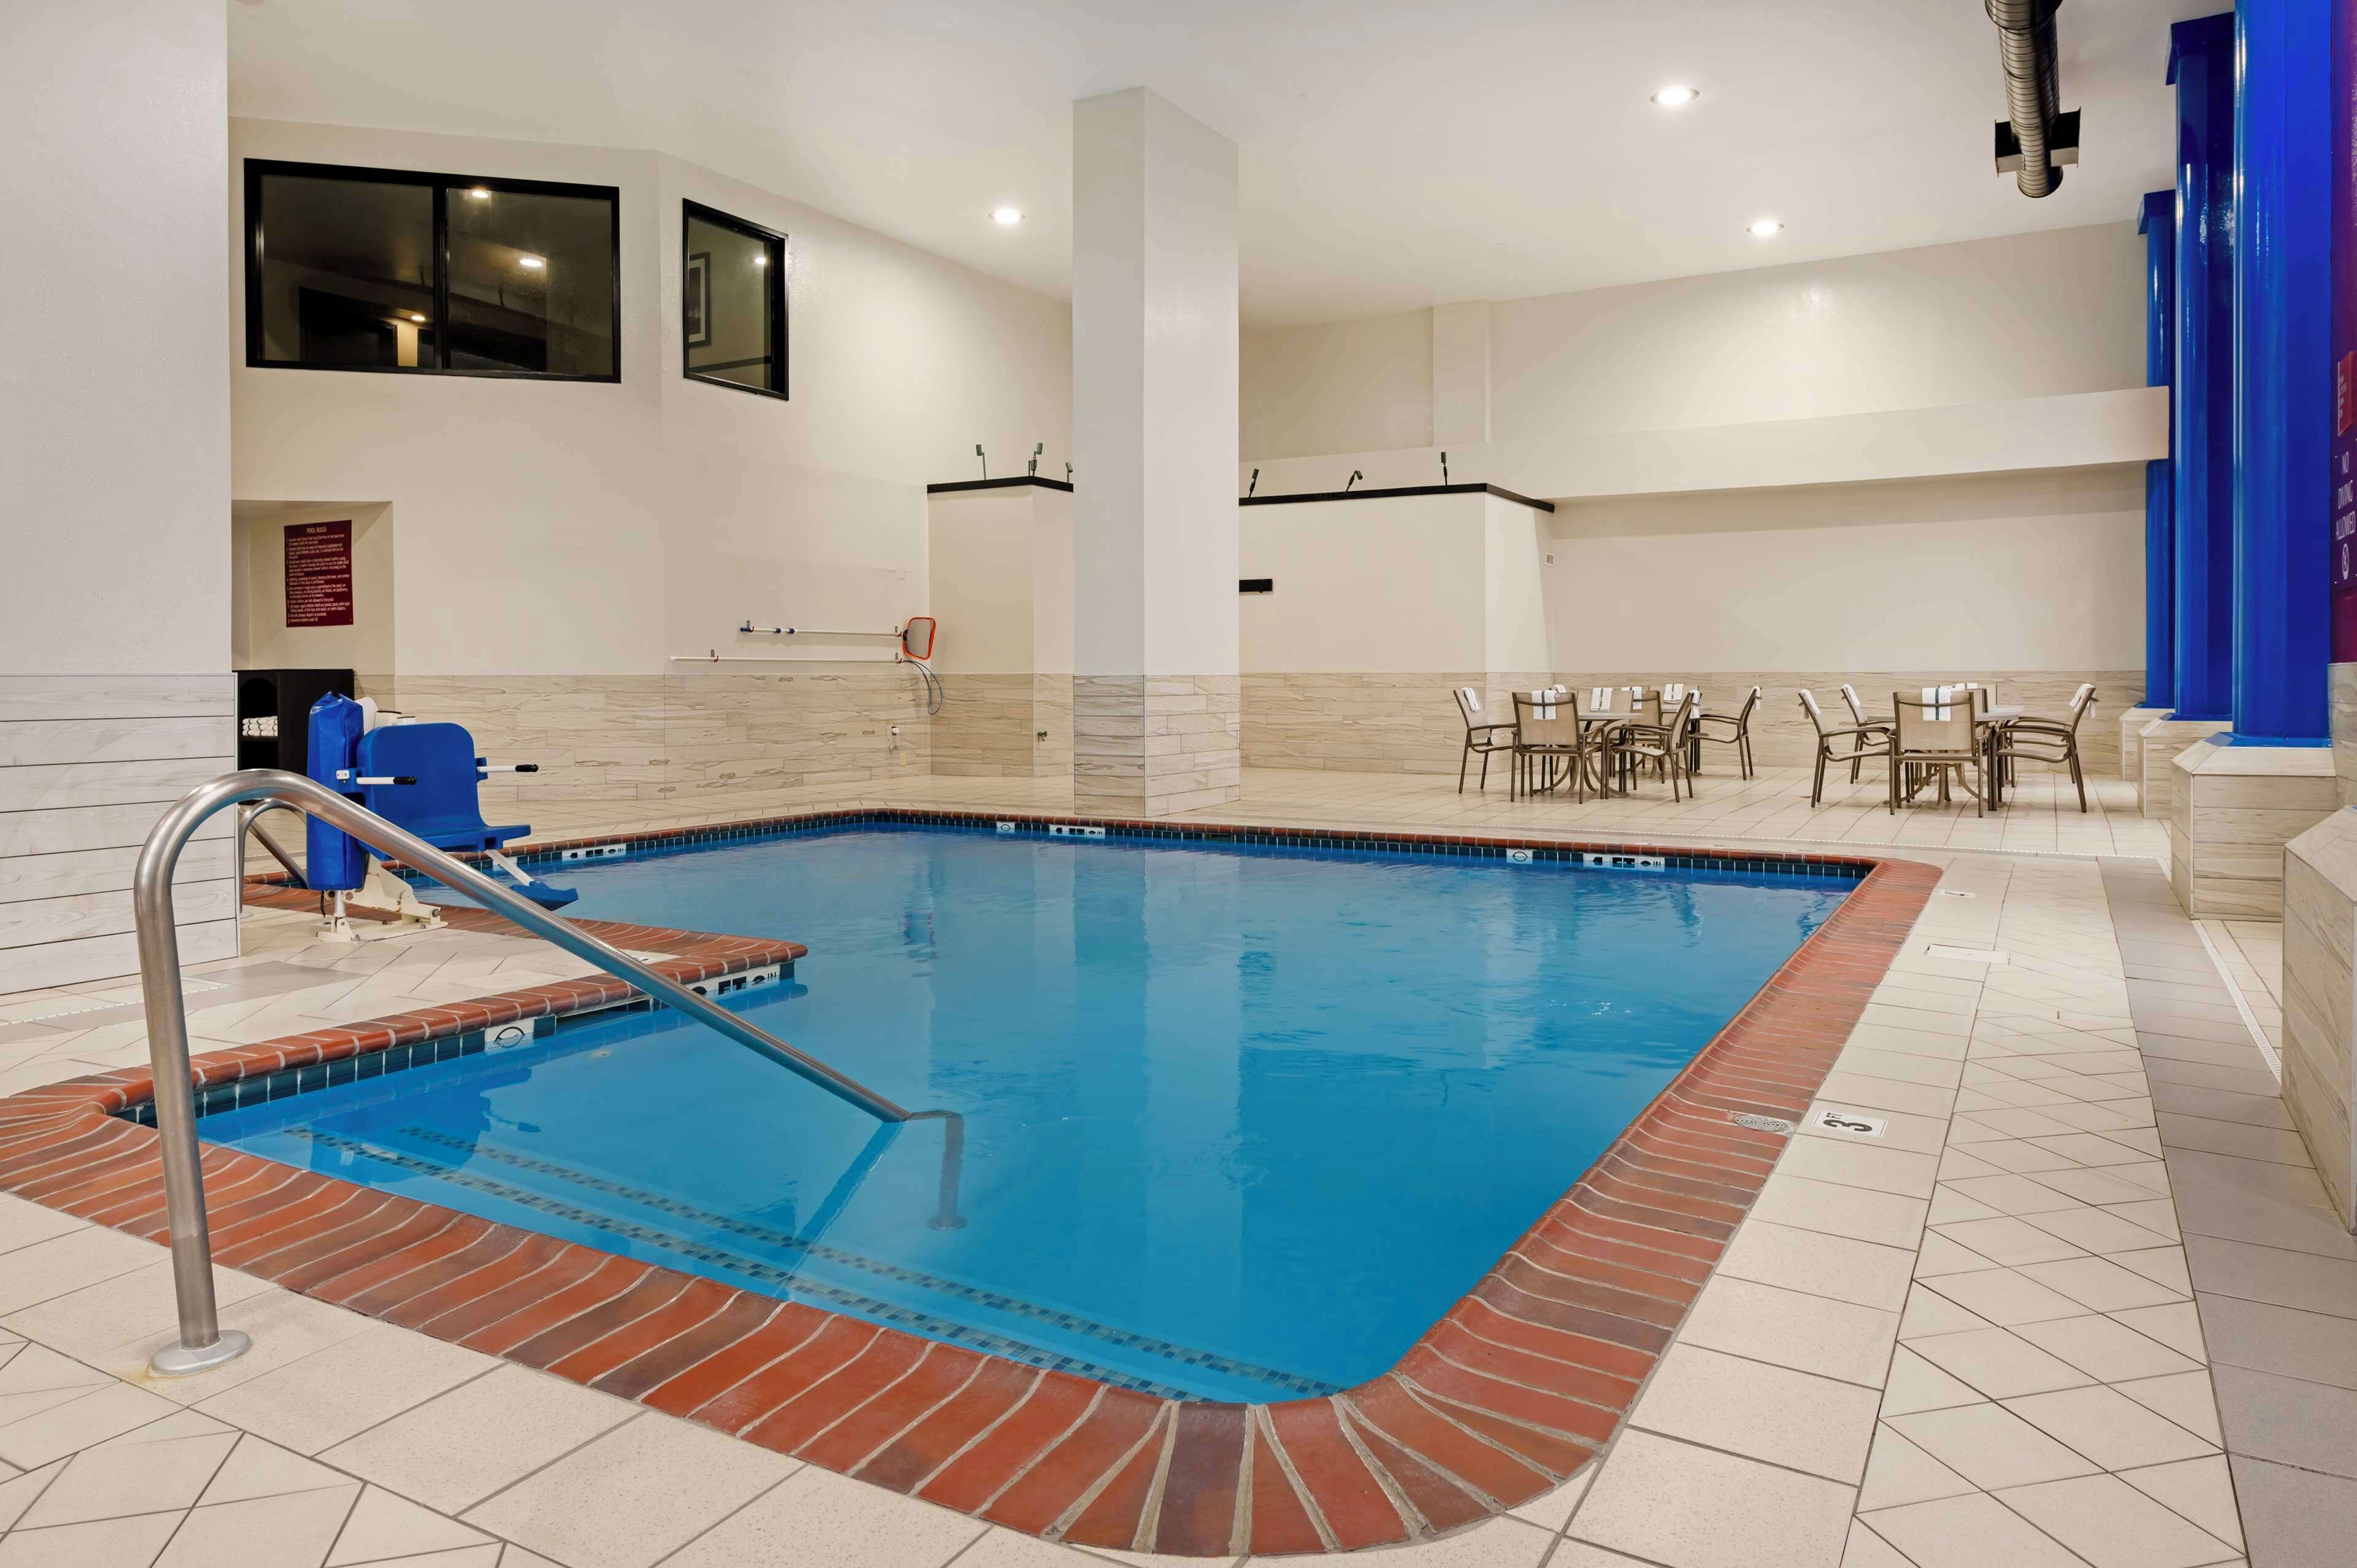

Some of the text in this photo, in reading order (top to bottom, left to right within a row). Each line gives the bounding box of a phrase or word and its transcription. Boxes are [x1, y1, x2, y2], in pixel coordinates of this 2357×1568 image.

[2342, 451, 2349, 476] NO
[2338, 479, 2353, 510] DIVING
[2336, 511, 2356, 541] ALLOWED
[1823, 1119, 1873, 1132] 3
